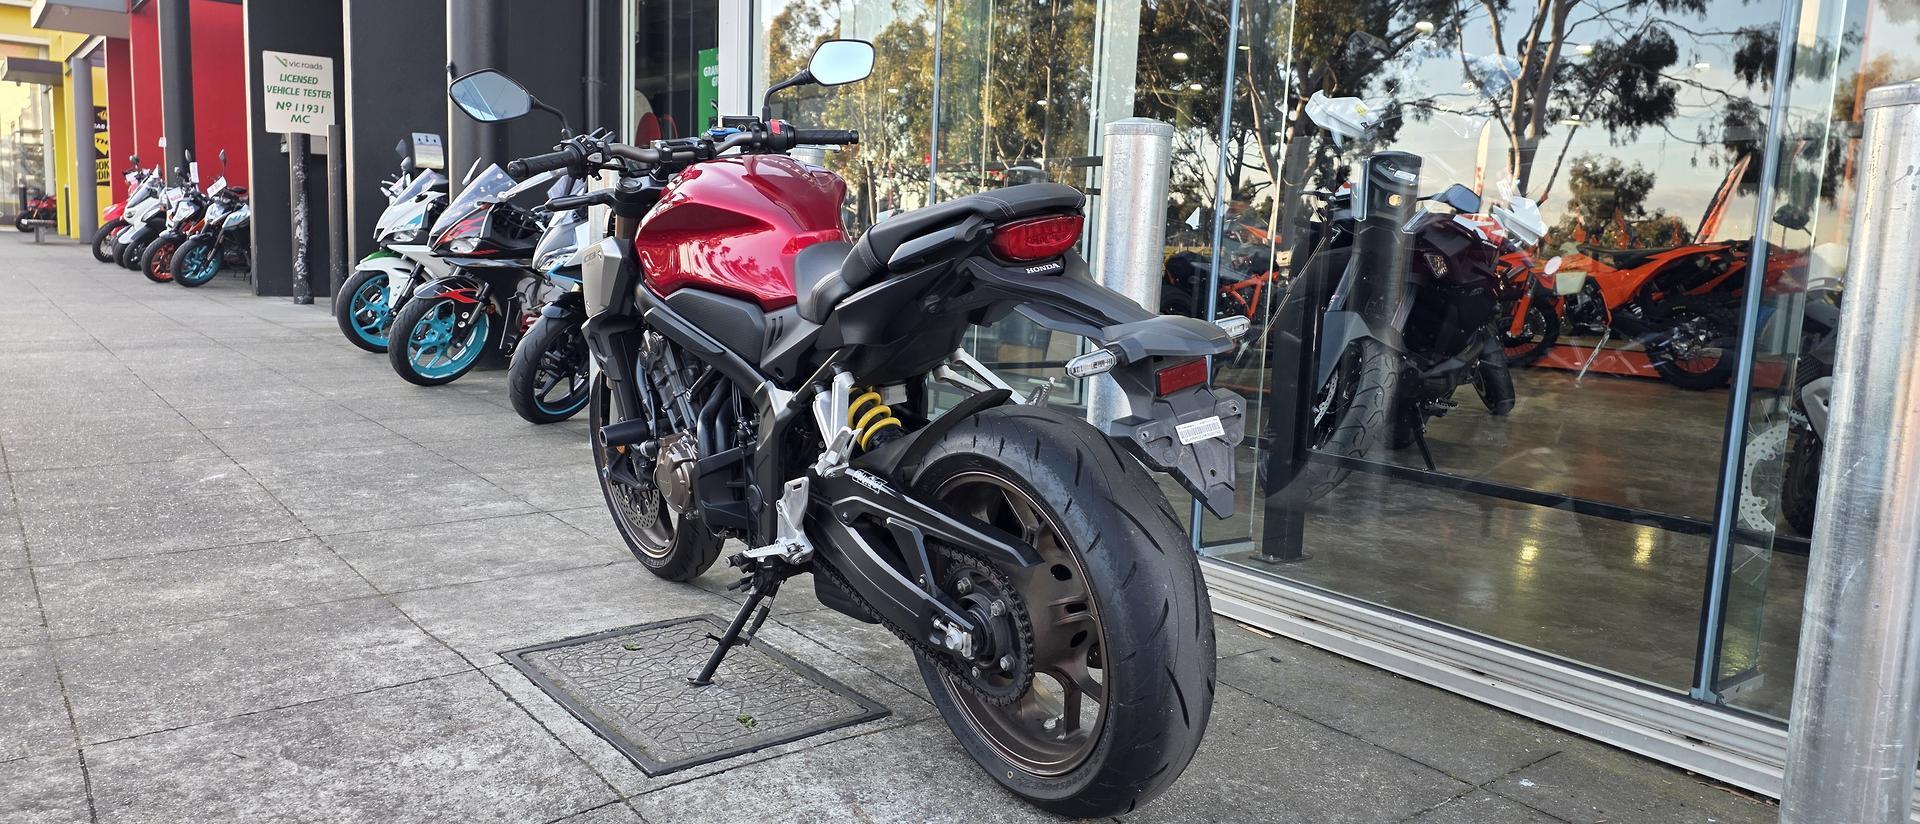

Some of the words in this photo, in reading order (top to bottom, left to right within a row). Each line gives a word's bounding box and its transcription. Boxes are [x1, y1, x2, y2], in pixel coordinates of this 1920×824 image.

[280, 73, 318, 85] LICENSED
[266, 85, 300, 96] VEHICLE
[303, 88, 332, 99] TESTER
[295, 103, 324, 114] 11931
[290, 114, 310, 124] MC
[1025, 262, 1060, 274] HONDA
